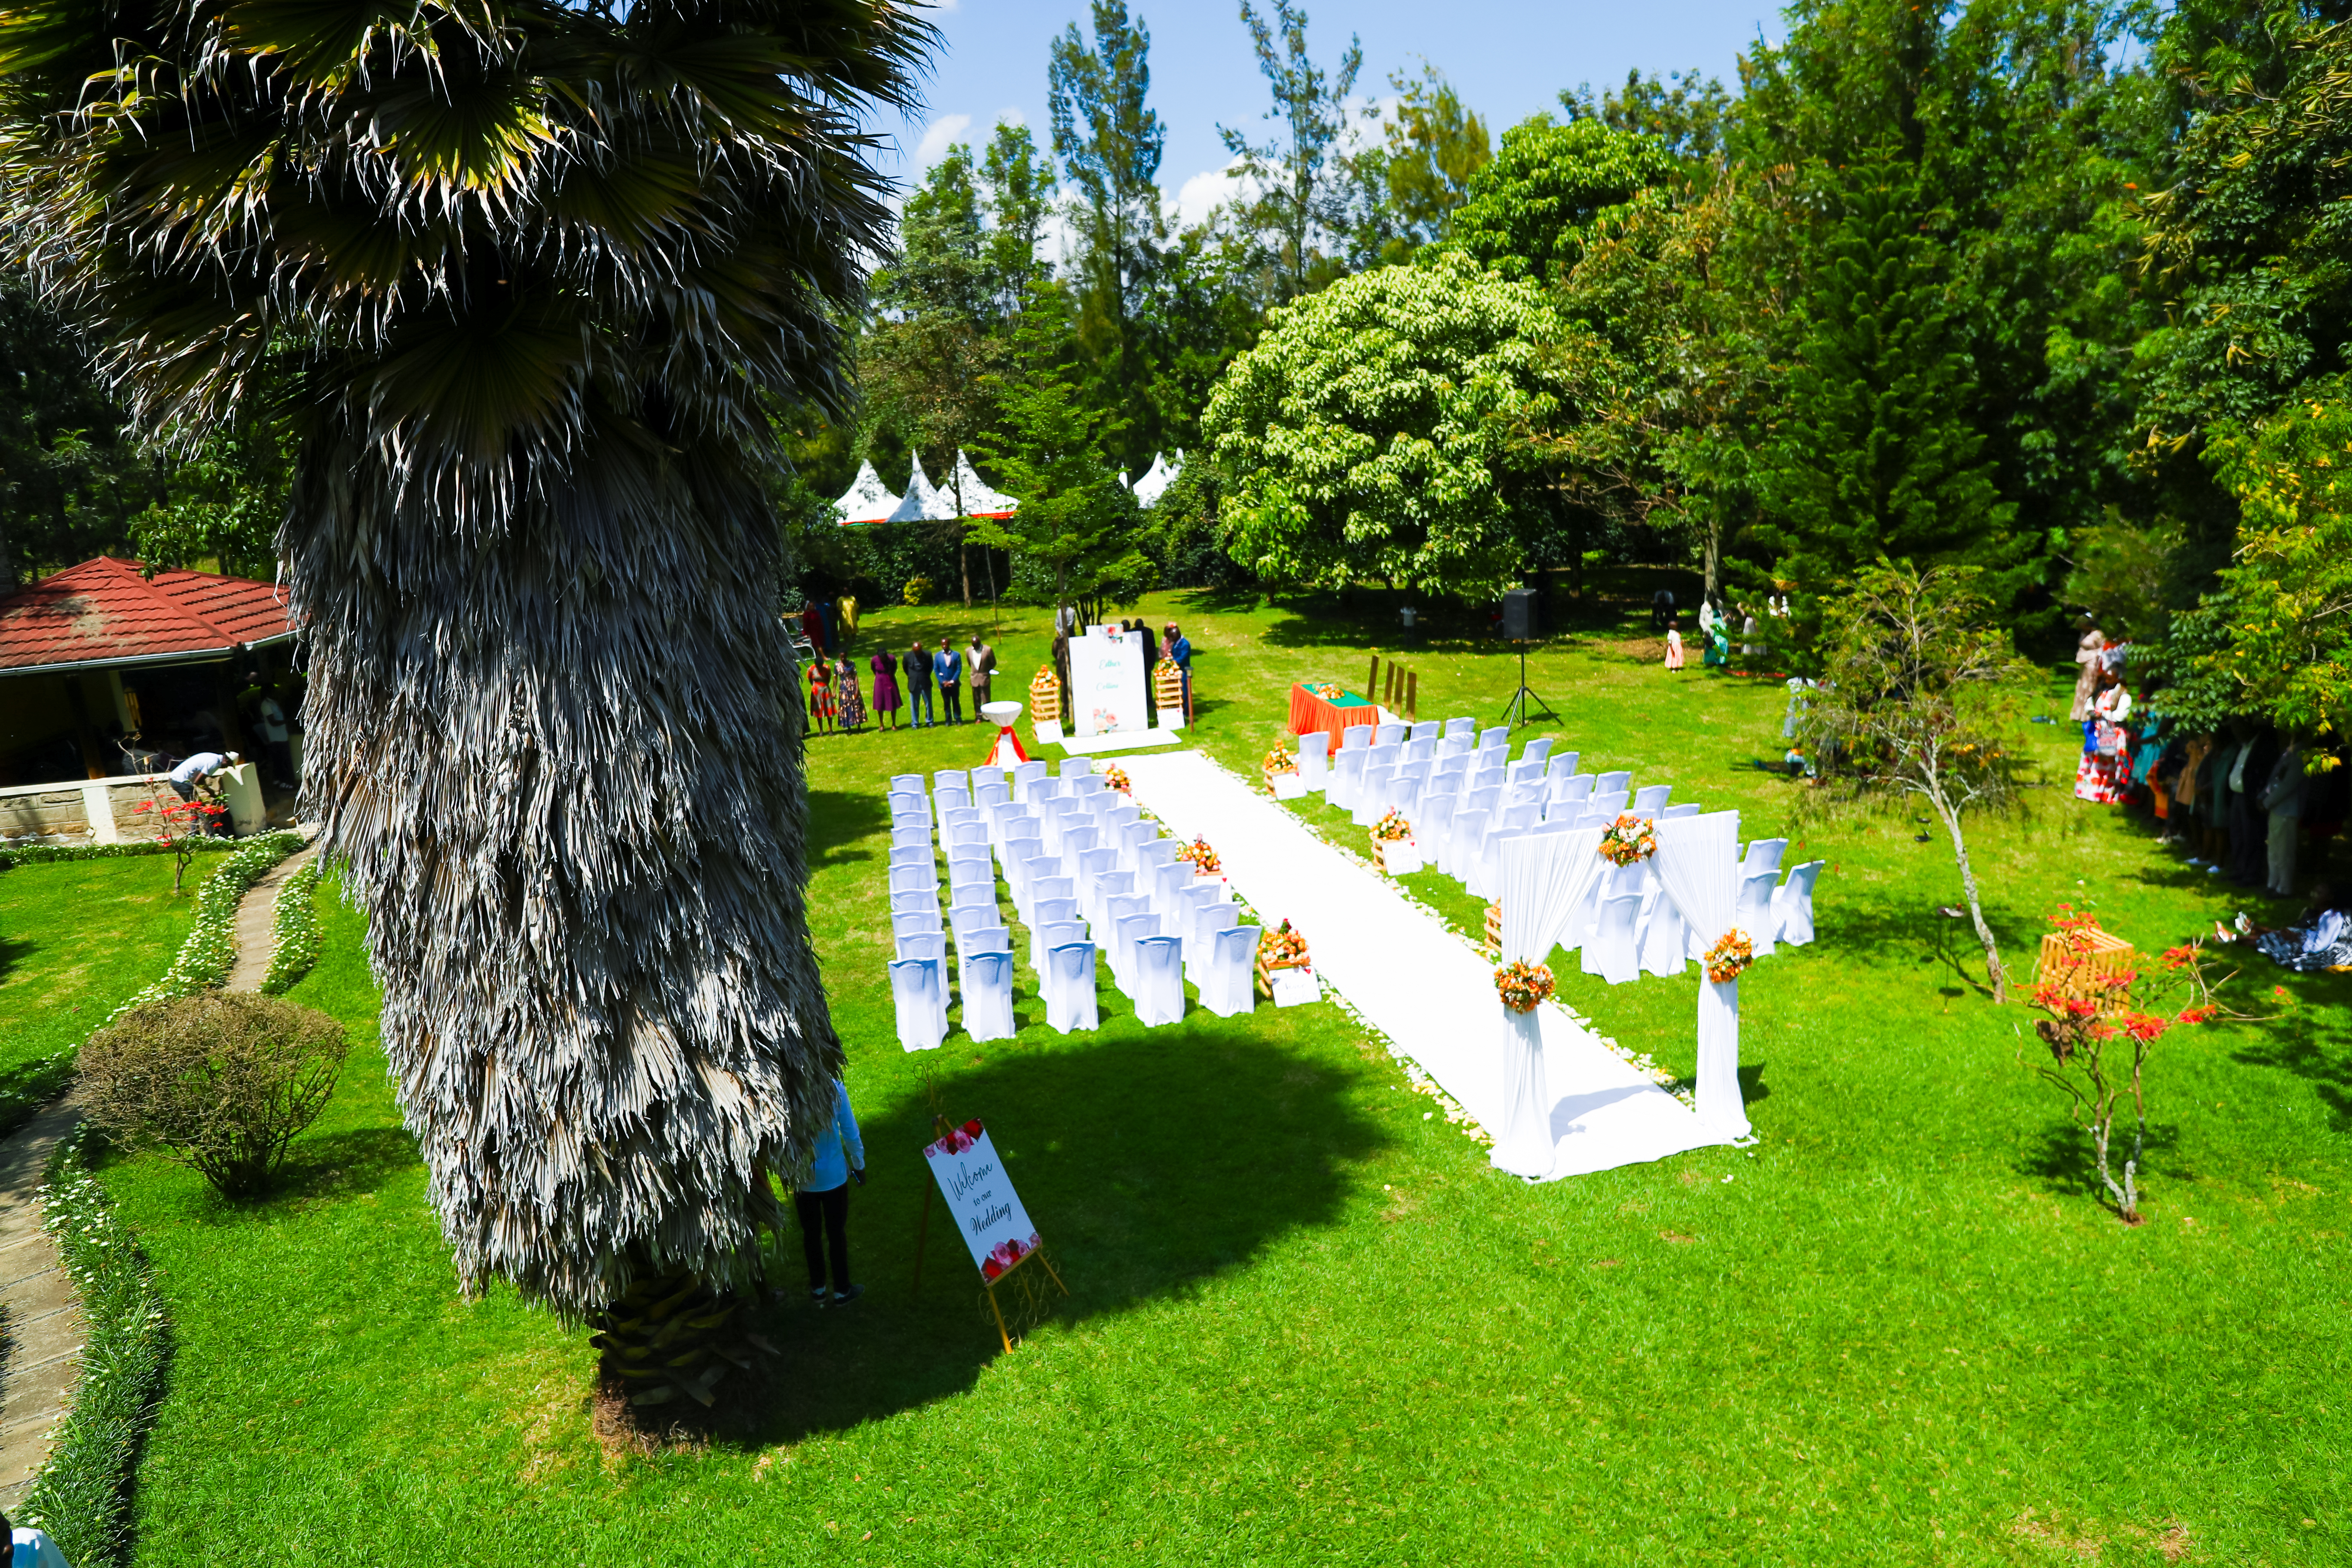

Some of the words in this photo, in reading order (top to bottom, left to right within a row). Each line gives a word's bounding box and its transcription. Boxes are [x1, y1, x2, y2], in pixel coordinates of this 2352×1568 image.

[1278, 983, 1305, 991] Never
[1288, 990, 1310, 1002] Fails
[947, 1162, 992, 1201] Welcome
[973, 1198, 980, 1206] to
[981, 1190, 992, 1201] our
[971, 1203, 1012, 1236] Wedding
